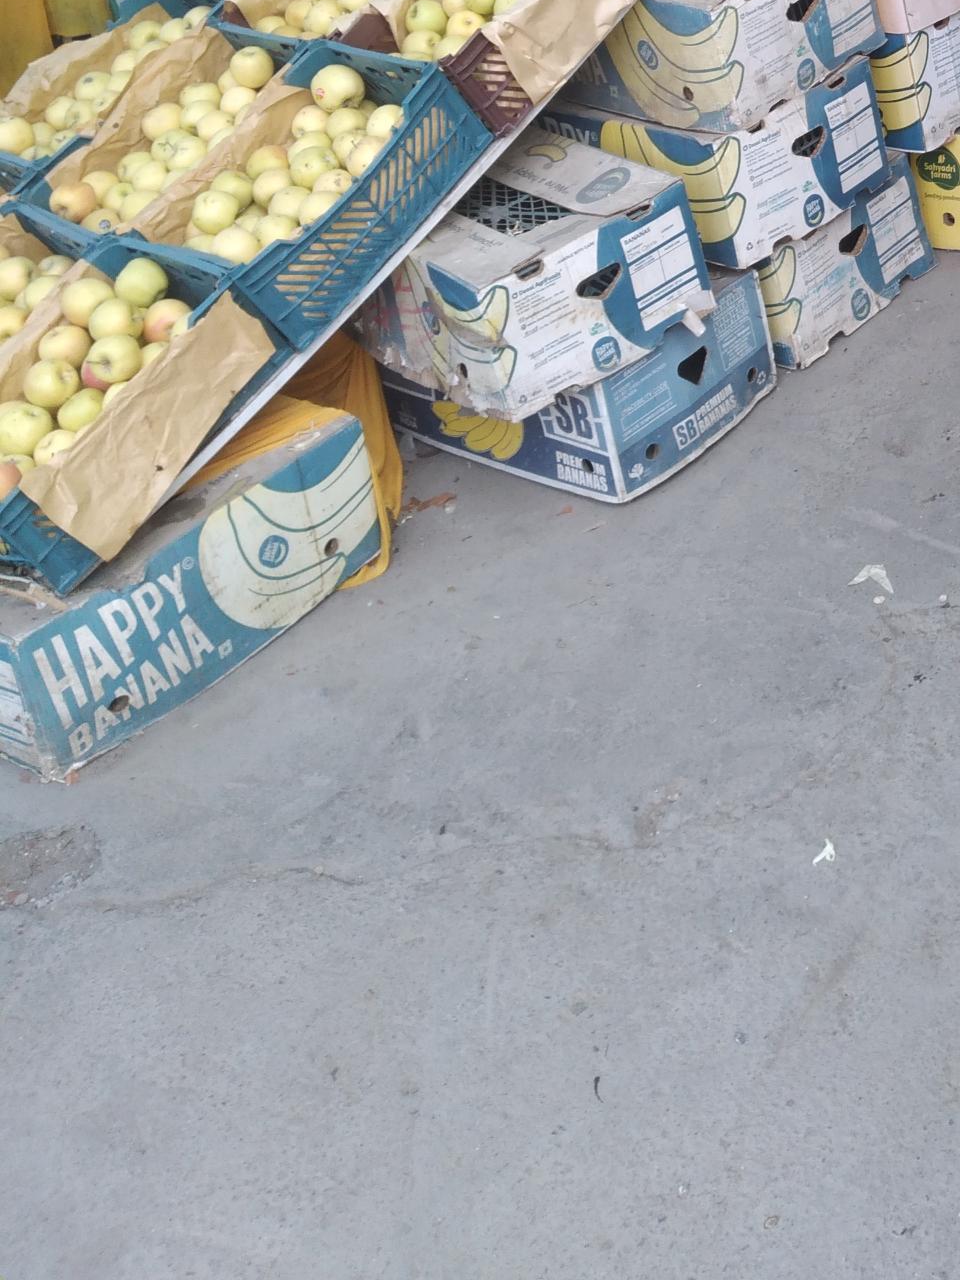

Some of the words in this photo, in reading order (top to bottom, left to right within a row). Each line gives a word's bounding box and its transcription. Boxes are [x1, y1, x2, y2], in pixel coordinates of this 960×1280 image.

[924, 160, 957, 175] Sahyadri
[930, 170, 952, 180] farms
[553, 392, 595, 440] SB
[676, 417, 697, 447] SB
[696, 384, 734, 420] PREMIUM
[699, 394, 737, 435] BANANAS
[556, 463, 608, 493] BANANAS
[33, 561, 189, 731] HAPPY
